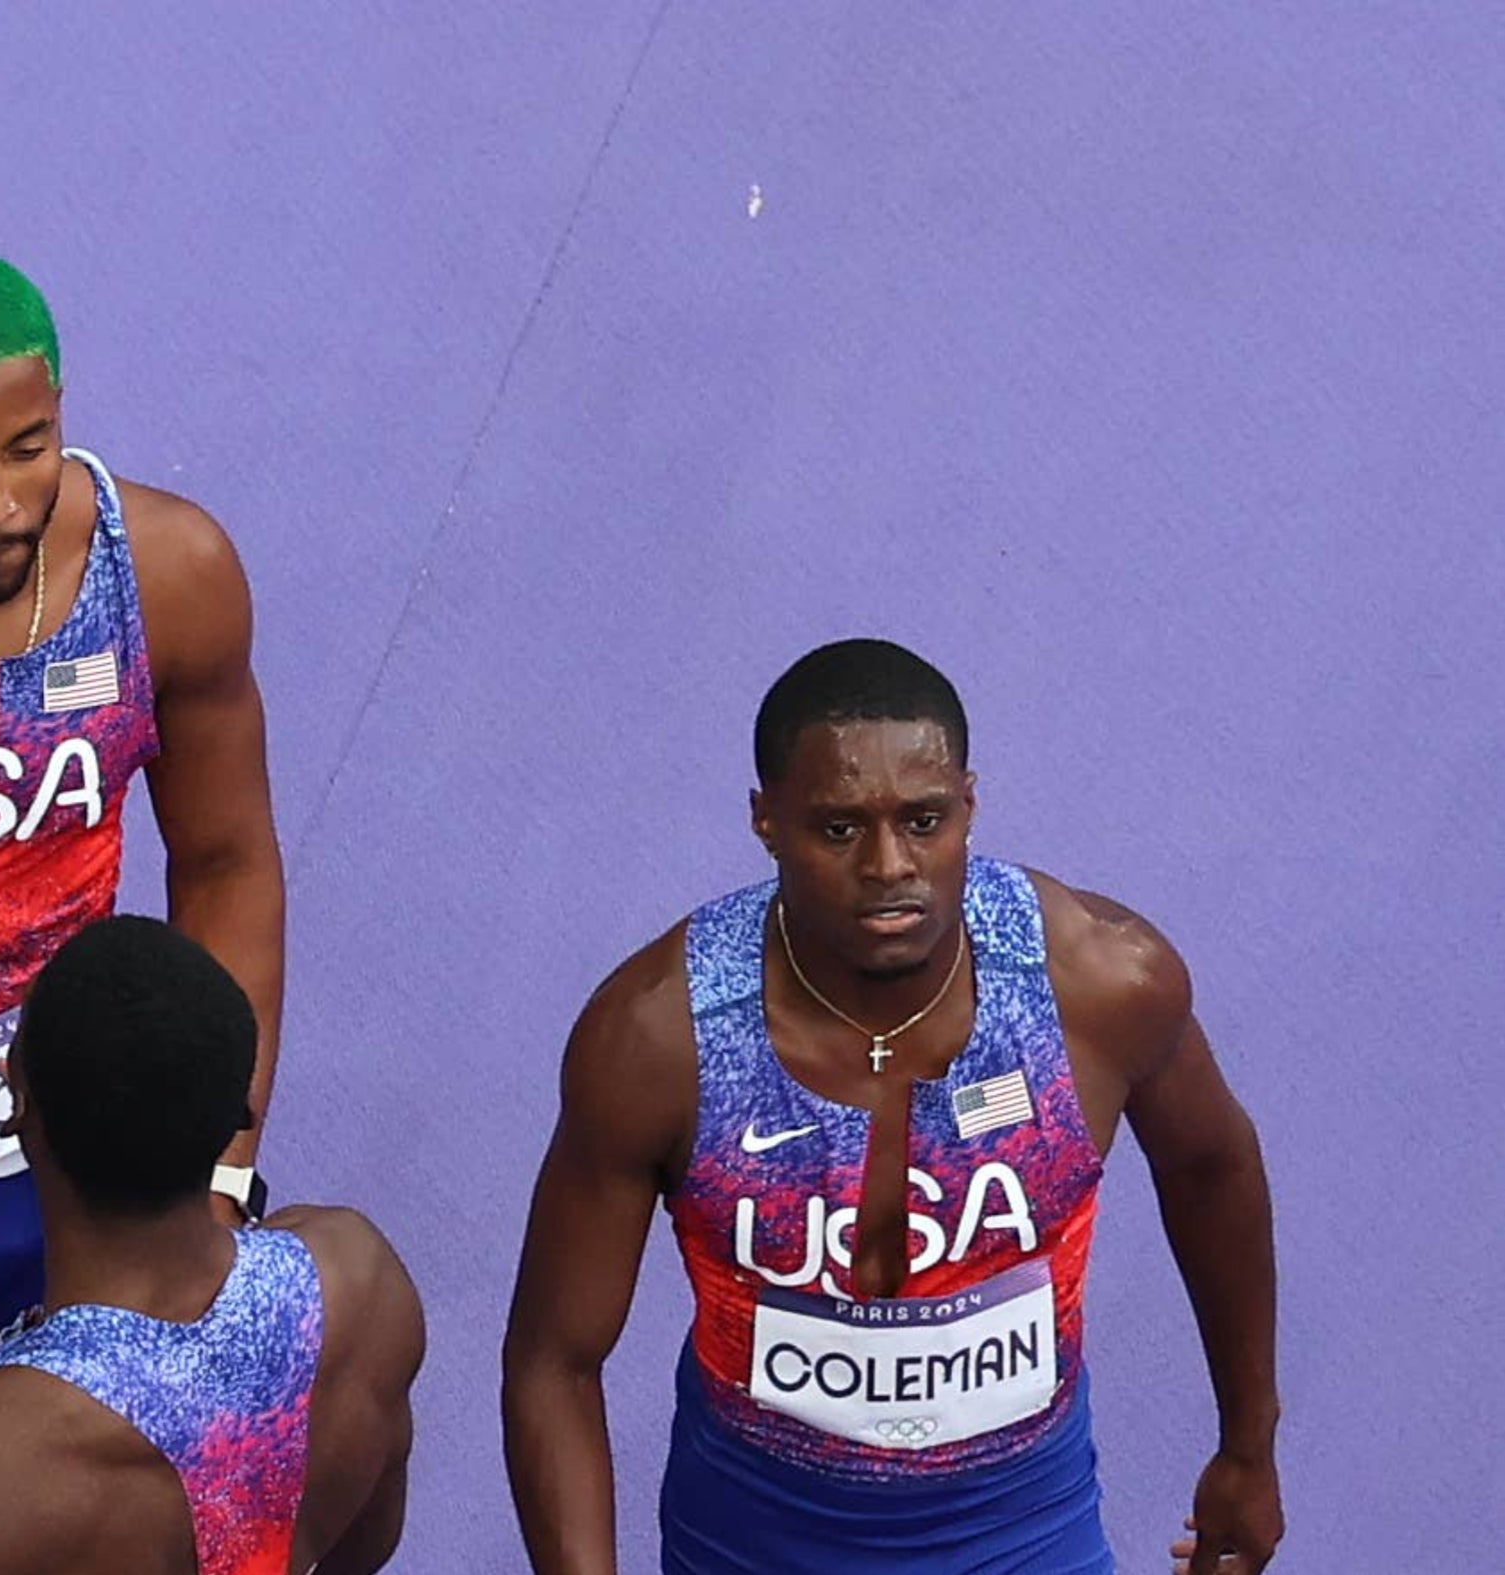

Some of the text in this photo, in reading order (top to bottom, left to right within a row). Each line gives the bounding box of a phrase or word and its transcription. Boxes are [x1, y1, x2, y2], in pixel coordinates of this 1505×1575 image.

[735, 1162, 1037, 1301] USA
[836, 1293, 982, 1321] PARIS 2024
[764, 1321, 1039, 1402] COLEMAN
